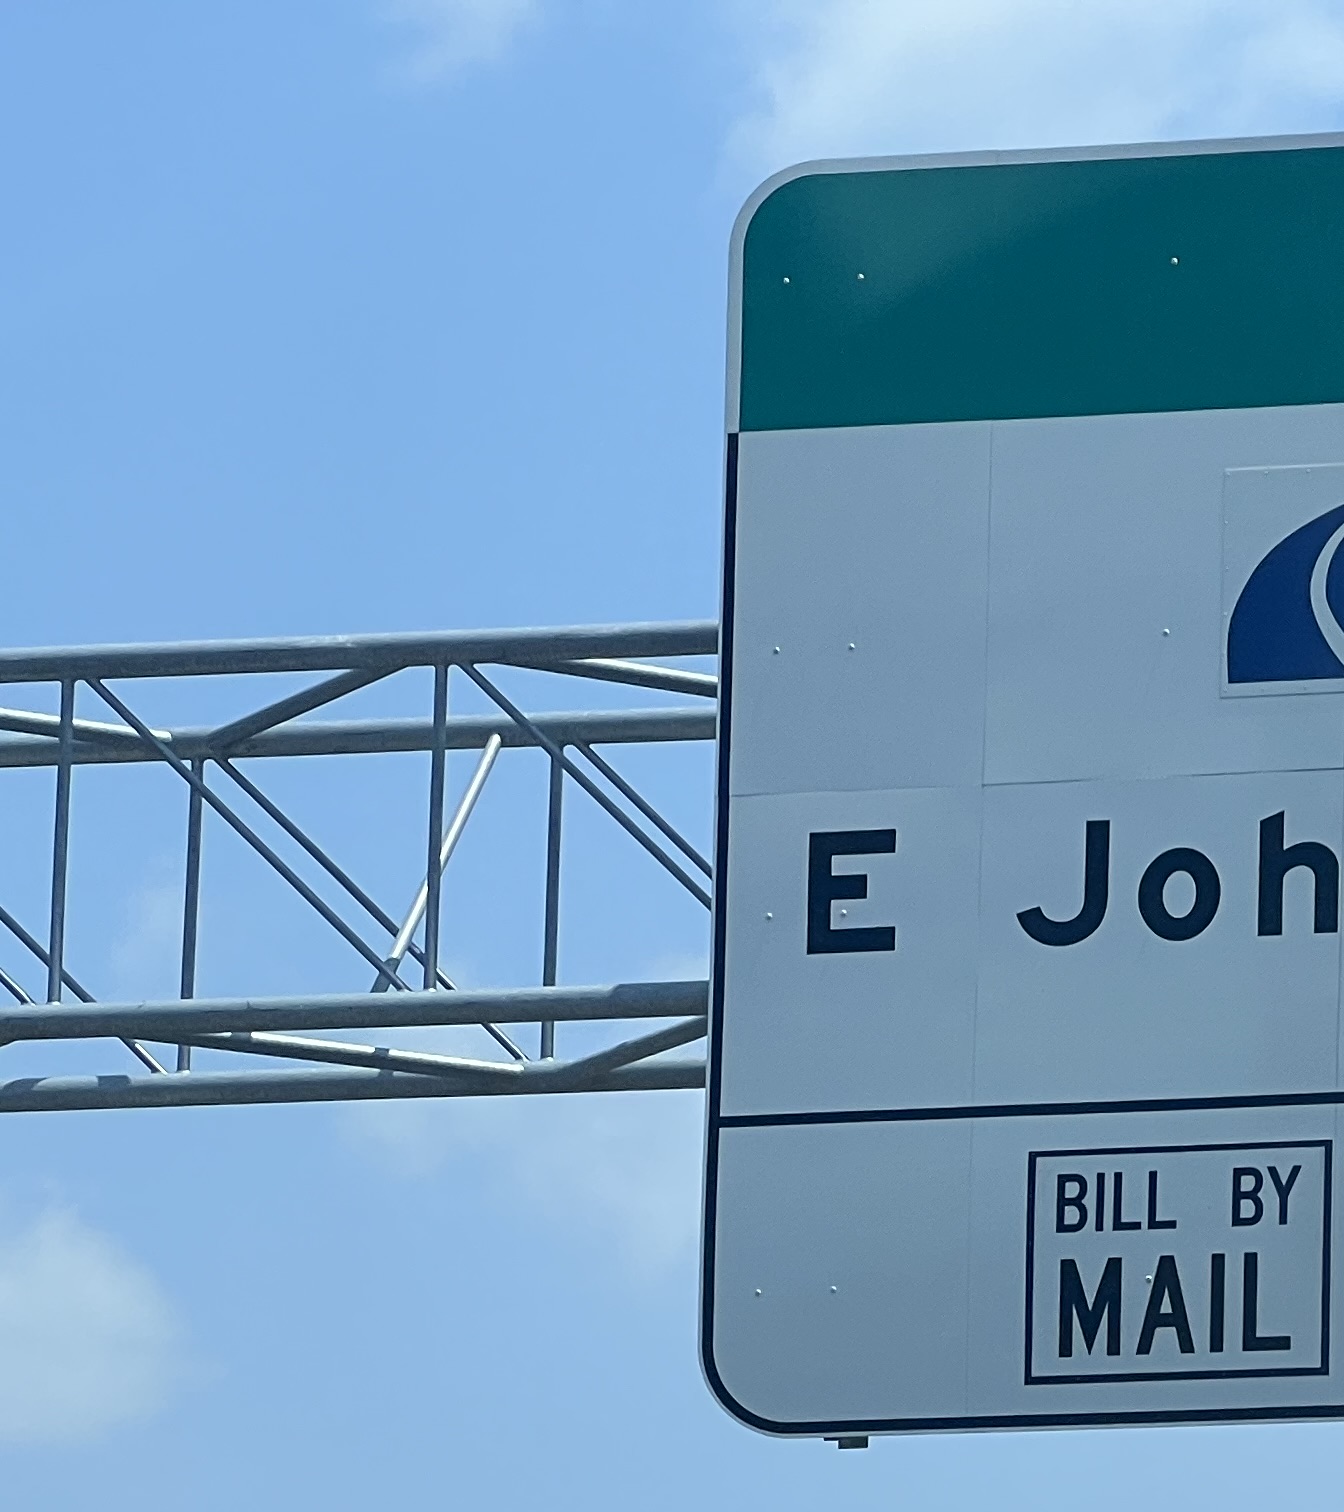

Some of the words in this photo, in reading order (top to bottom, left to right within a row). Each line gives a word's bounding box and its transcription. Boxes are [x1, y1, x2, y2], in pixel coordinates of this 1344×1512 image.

[805, 827, 898, 955] E
[1055, 1169, 1178, 1234] BILL
[1230, 1163, 1303, 1228] BY
[1057, 1251, 1293, 1358] MAIL
